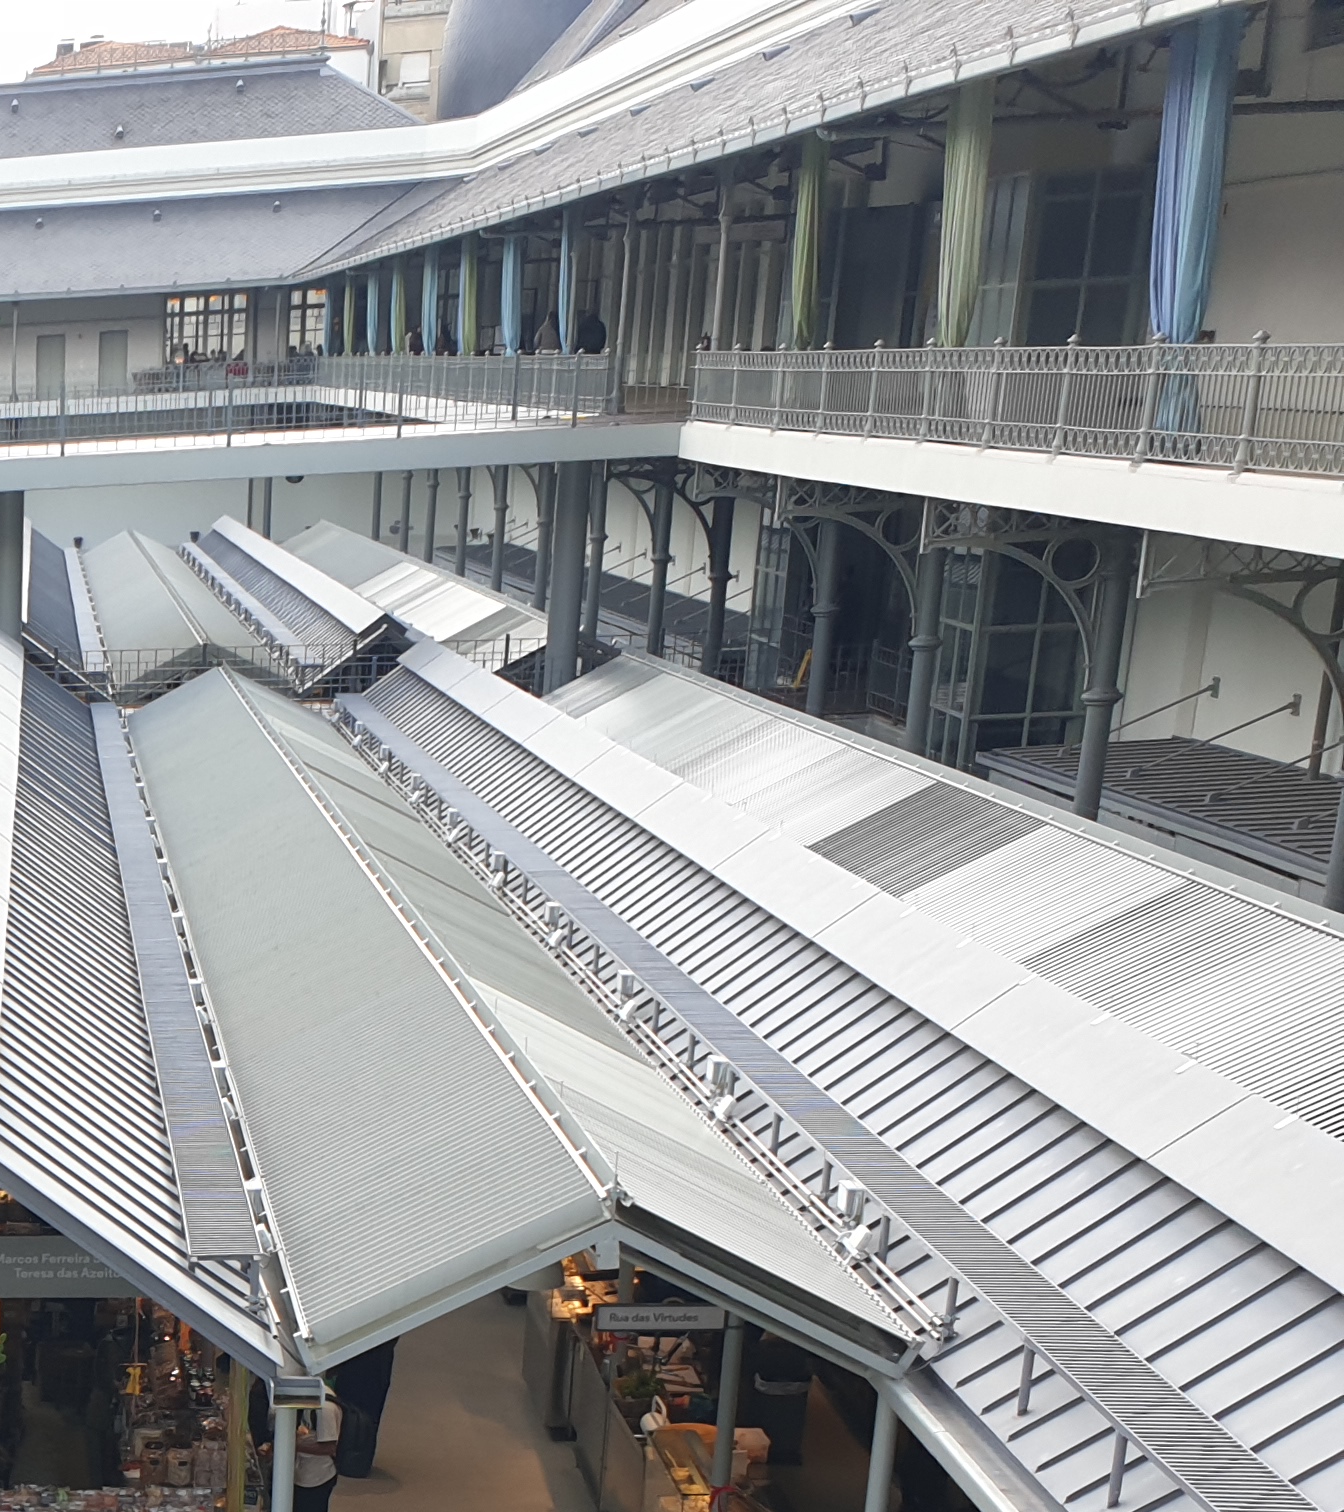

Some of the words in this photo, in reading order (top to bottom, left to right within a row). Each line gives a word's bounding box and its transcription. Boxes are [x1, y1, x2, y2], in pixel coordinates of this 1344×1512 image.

[41, 1253, 91, 1265] Ferreira
[14, 1267, 55, 1279] Teresa
[56, 1267, 79, 1279] das
[80, 1267, 121, 1279] Azeito
[609, 1312, 629, 1323] Rua
[631, 1312, 650, 1323] das
[652, 1312, 699, 1323] Virtudes
